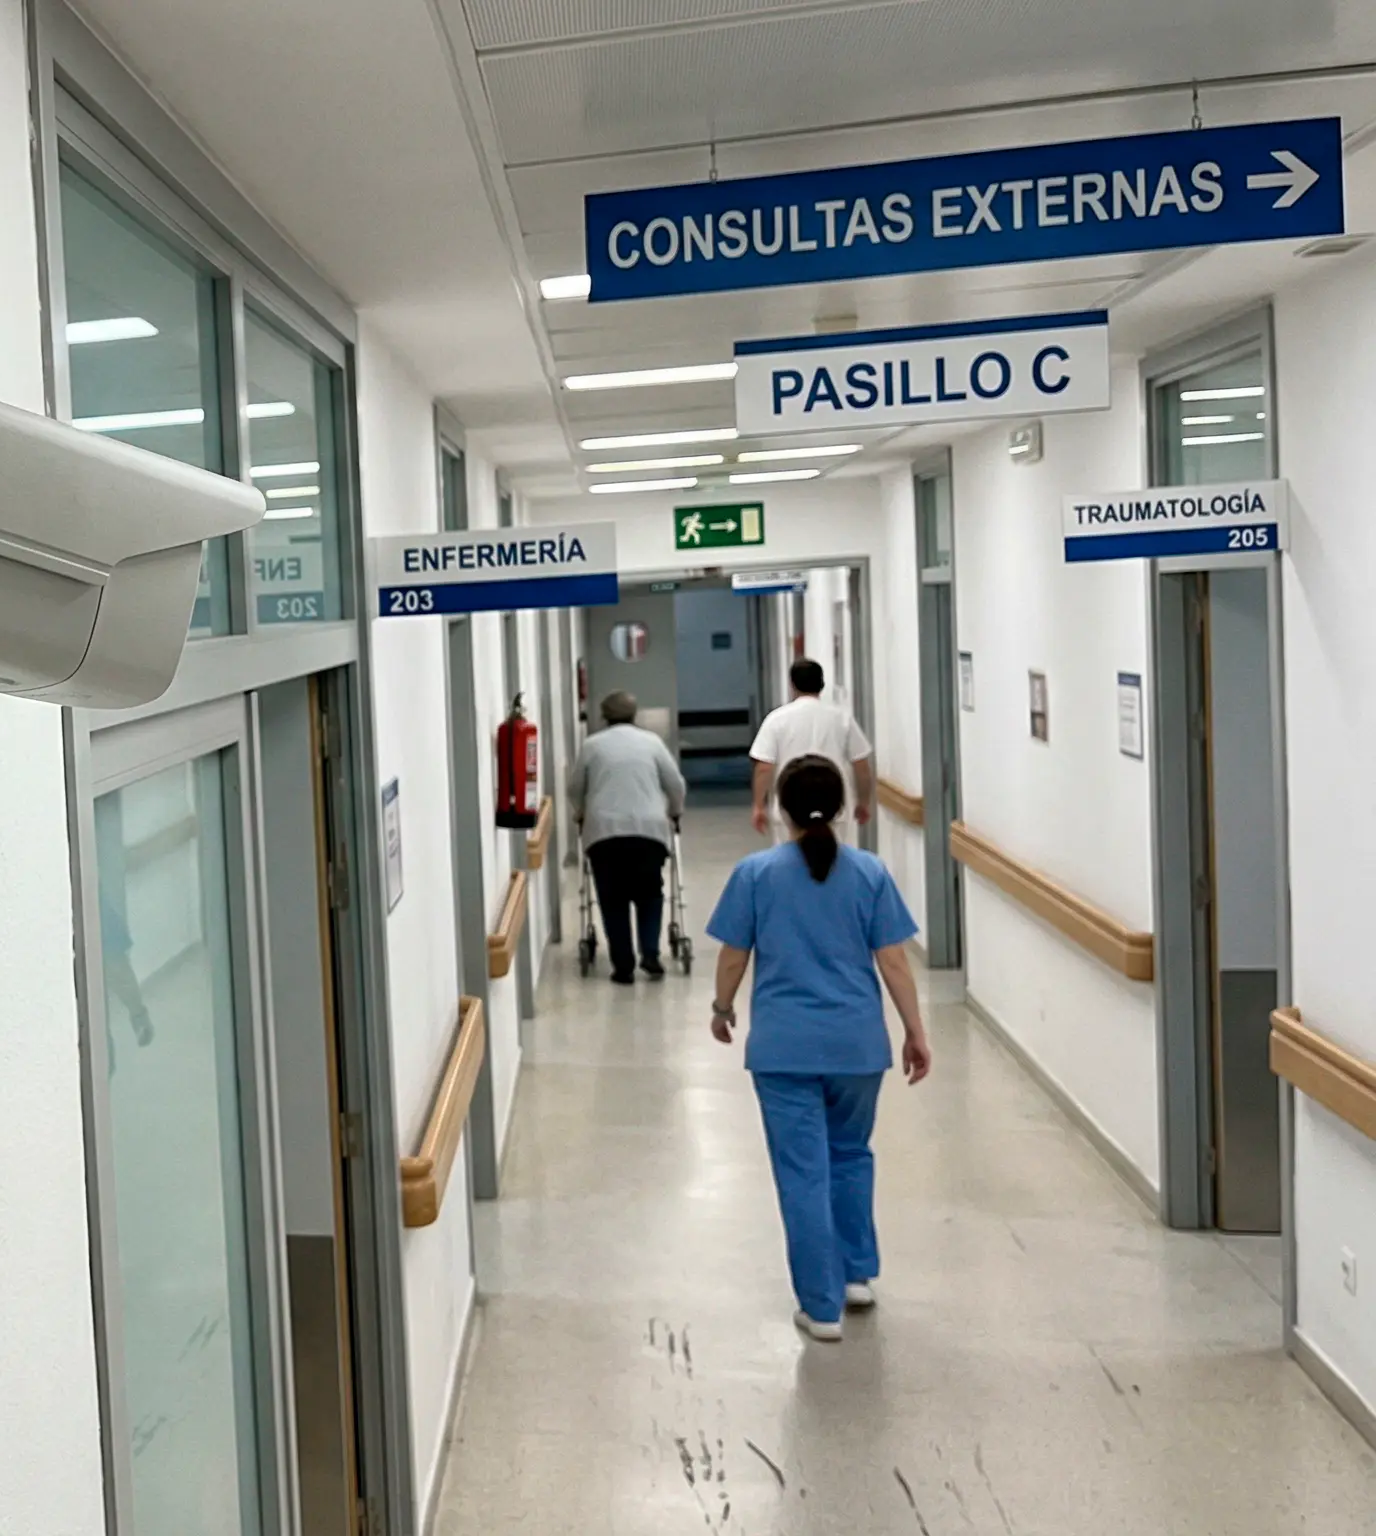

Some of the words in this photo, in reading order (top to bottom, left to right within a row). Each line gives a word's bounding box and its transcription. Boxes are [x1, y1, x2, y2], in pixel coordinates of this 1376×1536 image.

[607, 193, 914, 270] CONSULTAS
[931, 161, 1225, 239] EXTERNAS
[771, 351, 1013, 415] PASILLO
[1032, 345, 1071, 394] C
[1073, 488, 1267, 525] TRAUMATOLOGÍA
[403, 532, 587, 573] ENFERMERÍA
[1228, 527, 1269, 548] 205
[390, 589, 435, 613] 203
